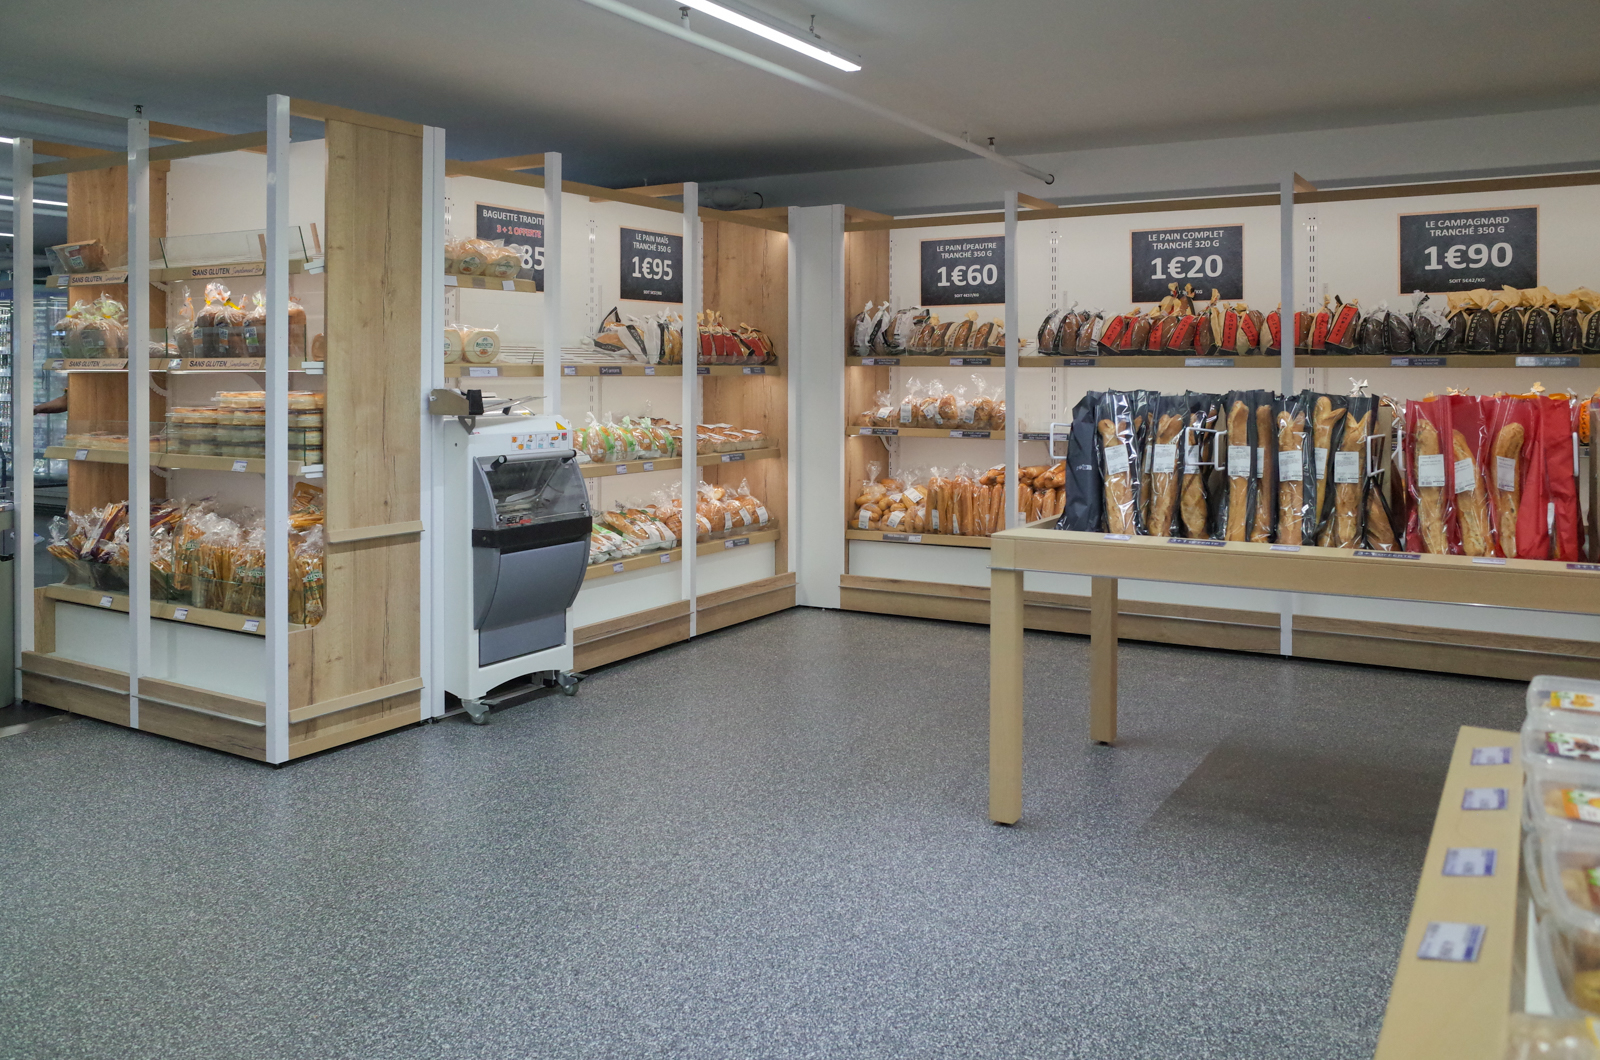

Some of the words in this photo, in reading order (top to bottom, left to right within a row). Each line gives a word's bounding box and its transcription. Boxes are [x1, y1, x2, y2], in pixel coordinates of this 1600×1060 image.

[483, 209, 518, 222] BAGUETTE
[1438, 216, 1509, 227] CAMPAGNARD
[497, 225, 502, 233] 3
[508, 226, 513, 234] 1
[513, 227, 542, 238] OFFERTE
[1182, 231, 1224, 239] COMPLET
[1430, 227, 1475, 237] TRANCHÉ
[1477, 226, 1495, 234] 350
[636, 233, 642, 241] LE
[643, 234, 655, 242] PAIN
[656, 236, 669, 244] MAÏS
[633, 242, 657, 252] TRANCHÉ
[1152, 241, 1192, 250] TRANCHÉ
[1195, 240, 1211, 248] 320
[941, 251, 972, 259] TRANCHÉ
[1424, 242, 1513, 270] 1€90
[209, 267, 230, 275] GLUTEN
[632, 256, 673, 281] 1€95
[1151, 255, 1223, 279] 1€20
[937, 264, 998, 287] 1€60
[189, 360, 205, 368] SANS
[205, 360, 228, 368] GLUTEN
[506, 515, 524, 525] SELF
